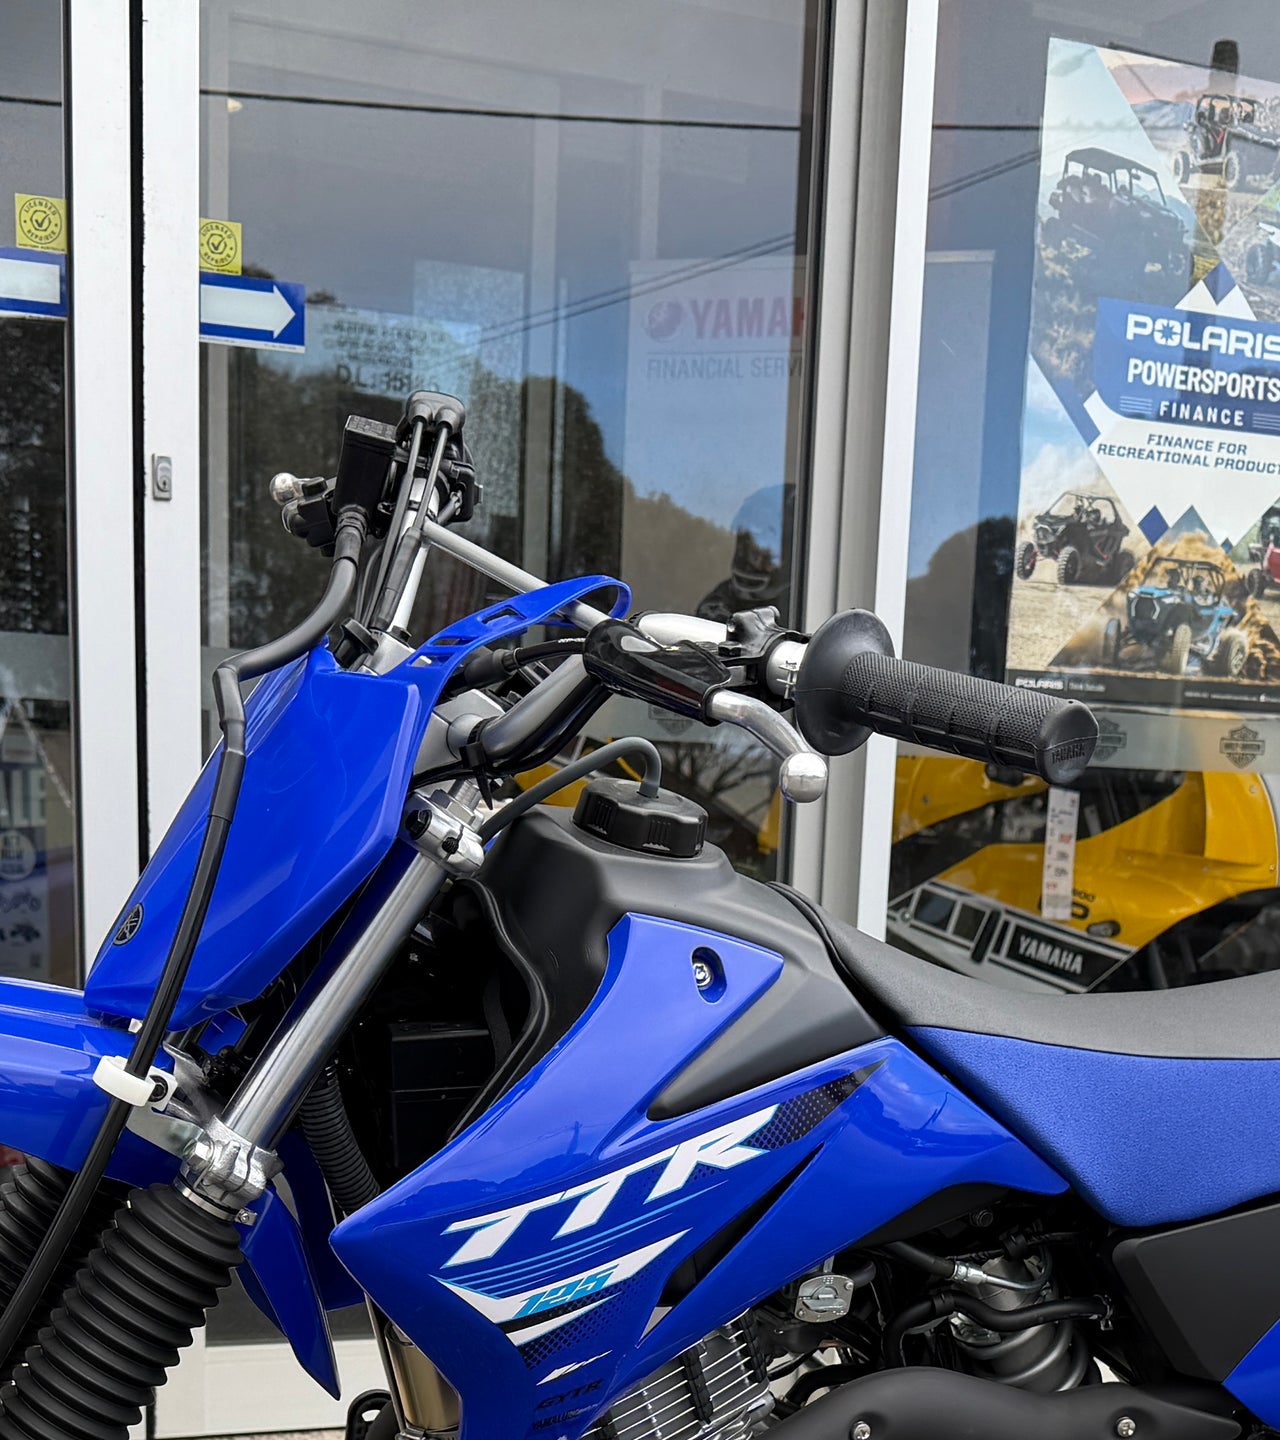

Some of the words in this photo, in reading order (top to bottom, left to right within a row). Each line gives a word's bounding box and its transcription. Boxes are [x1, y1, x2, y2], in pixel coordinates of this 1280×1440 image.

[646, 357, 744, 379] FINANCIAL
[1159, 401, 1245, 427] FINANCE
[1097, 443, 1210, 468] RECREATIONAL
[1147, 433, 1214, 452] FINANCE
[1219, 442, 1248, 456] FOR
[1018, 936, 1084, 975] YAMAHA
[440, 1103, 781, 1269] TTR
[512, 1262, 621, 1320] 125
